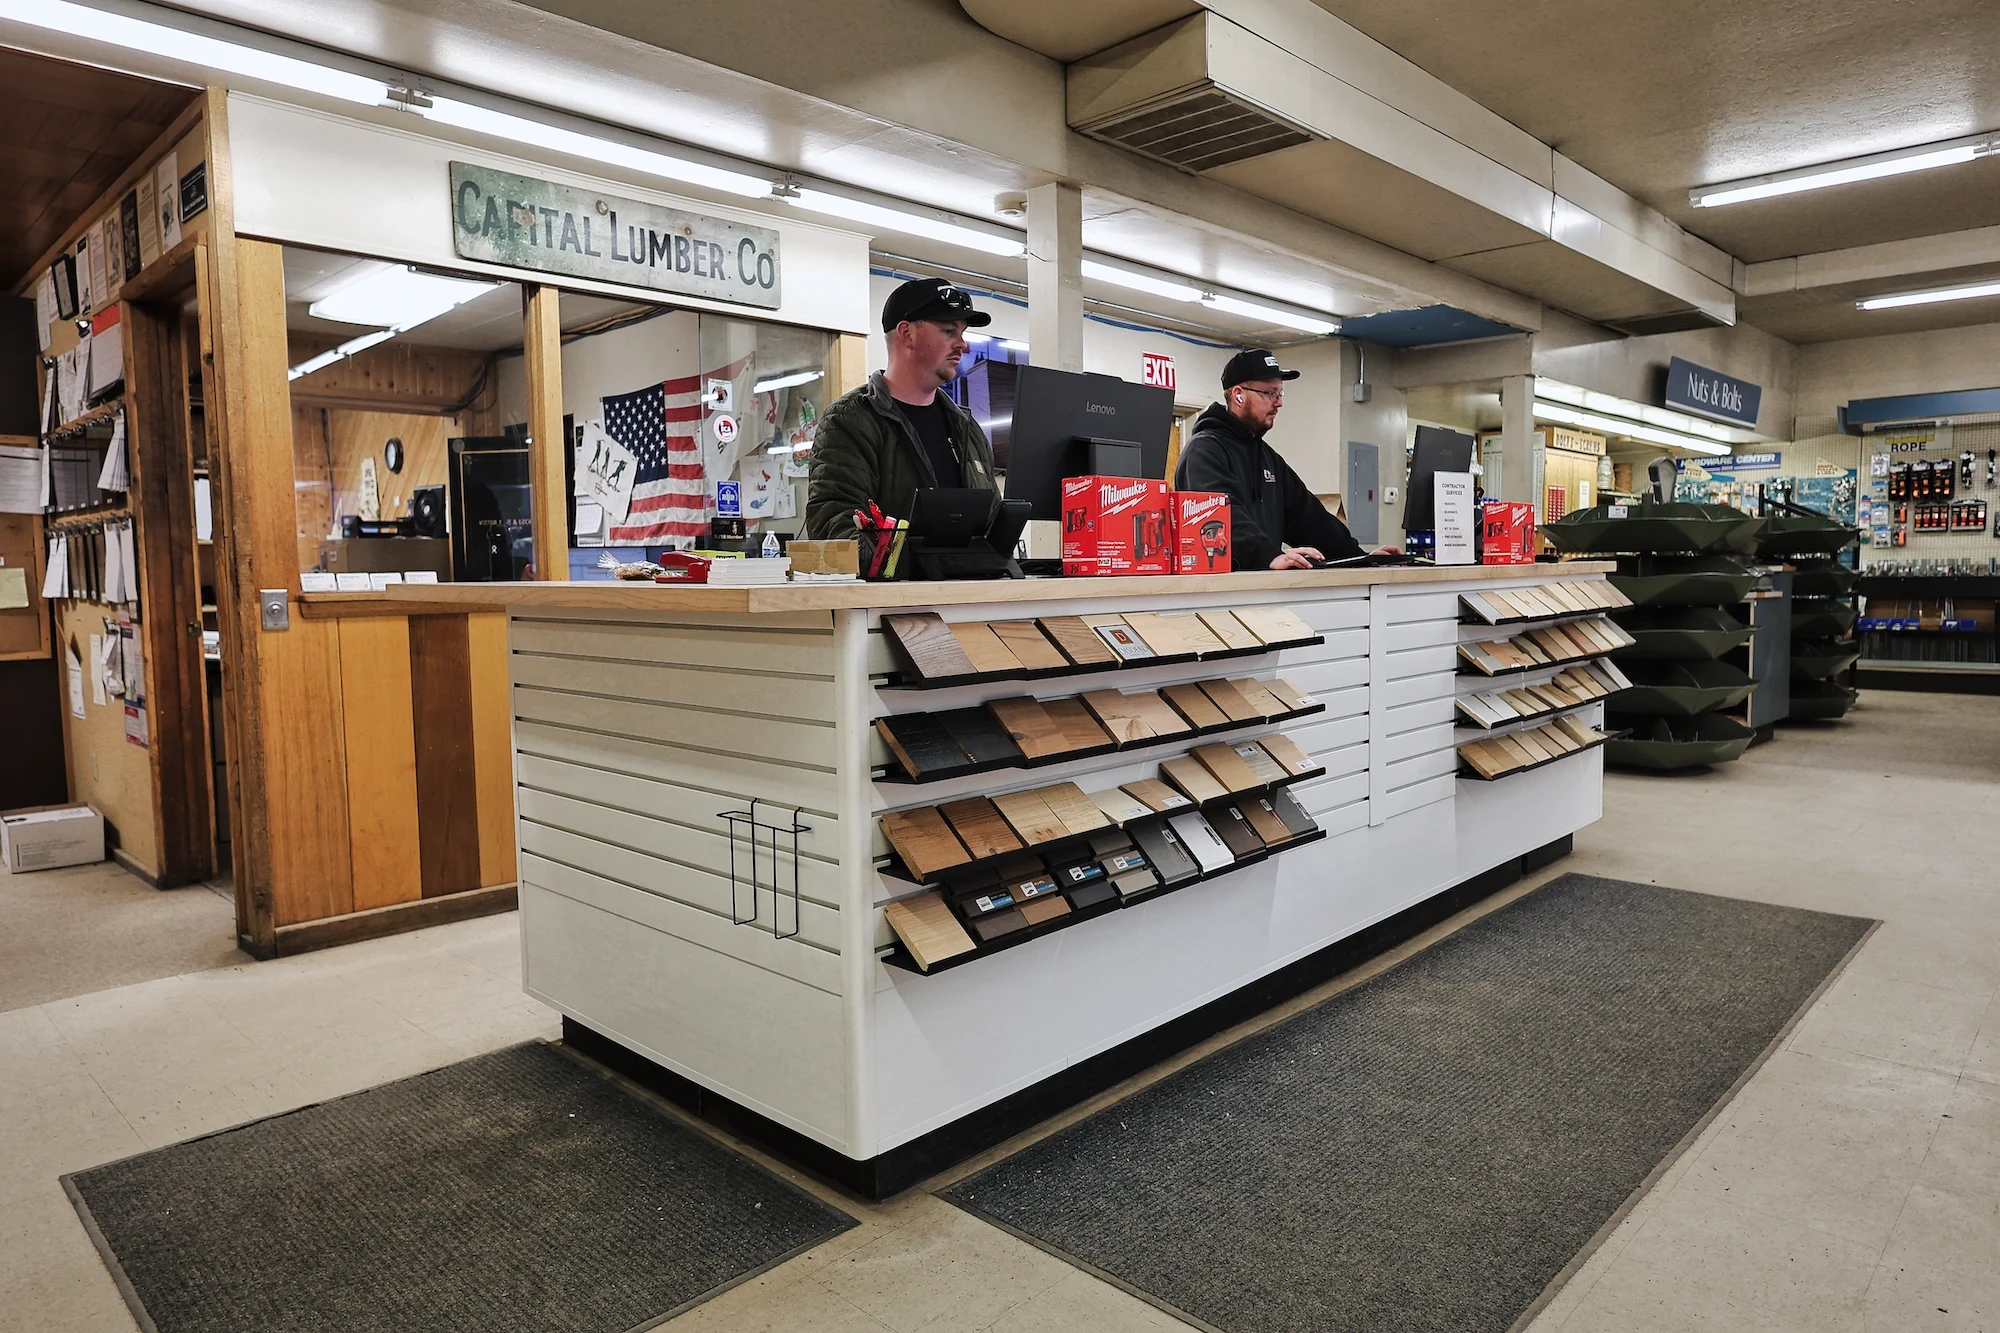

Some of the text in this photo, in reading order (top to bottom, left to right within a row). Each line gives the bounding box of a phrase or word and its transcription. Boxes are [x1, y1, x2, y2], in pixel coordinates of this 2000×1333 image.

[457, 180, 601, 258] CAPITAL
[609, 211, 726, 282] LUMBER
[1143, 357, 1176, 389] EXIT
[1687, 371, 1743, 413] Nuts & Bolts
[1086, 401, 1116, 415] Lenovo
[1555, 433, 1575, 449] BOLTS
[1891, 442, 1926, 453] ROPE
[1680, 453, 1776, 468] HRDWARE CENTER
[1064, 479, 1093, 494] Milwaukee
[1097, 480, 1148, 508] Milwaukee
